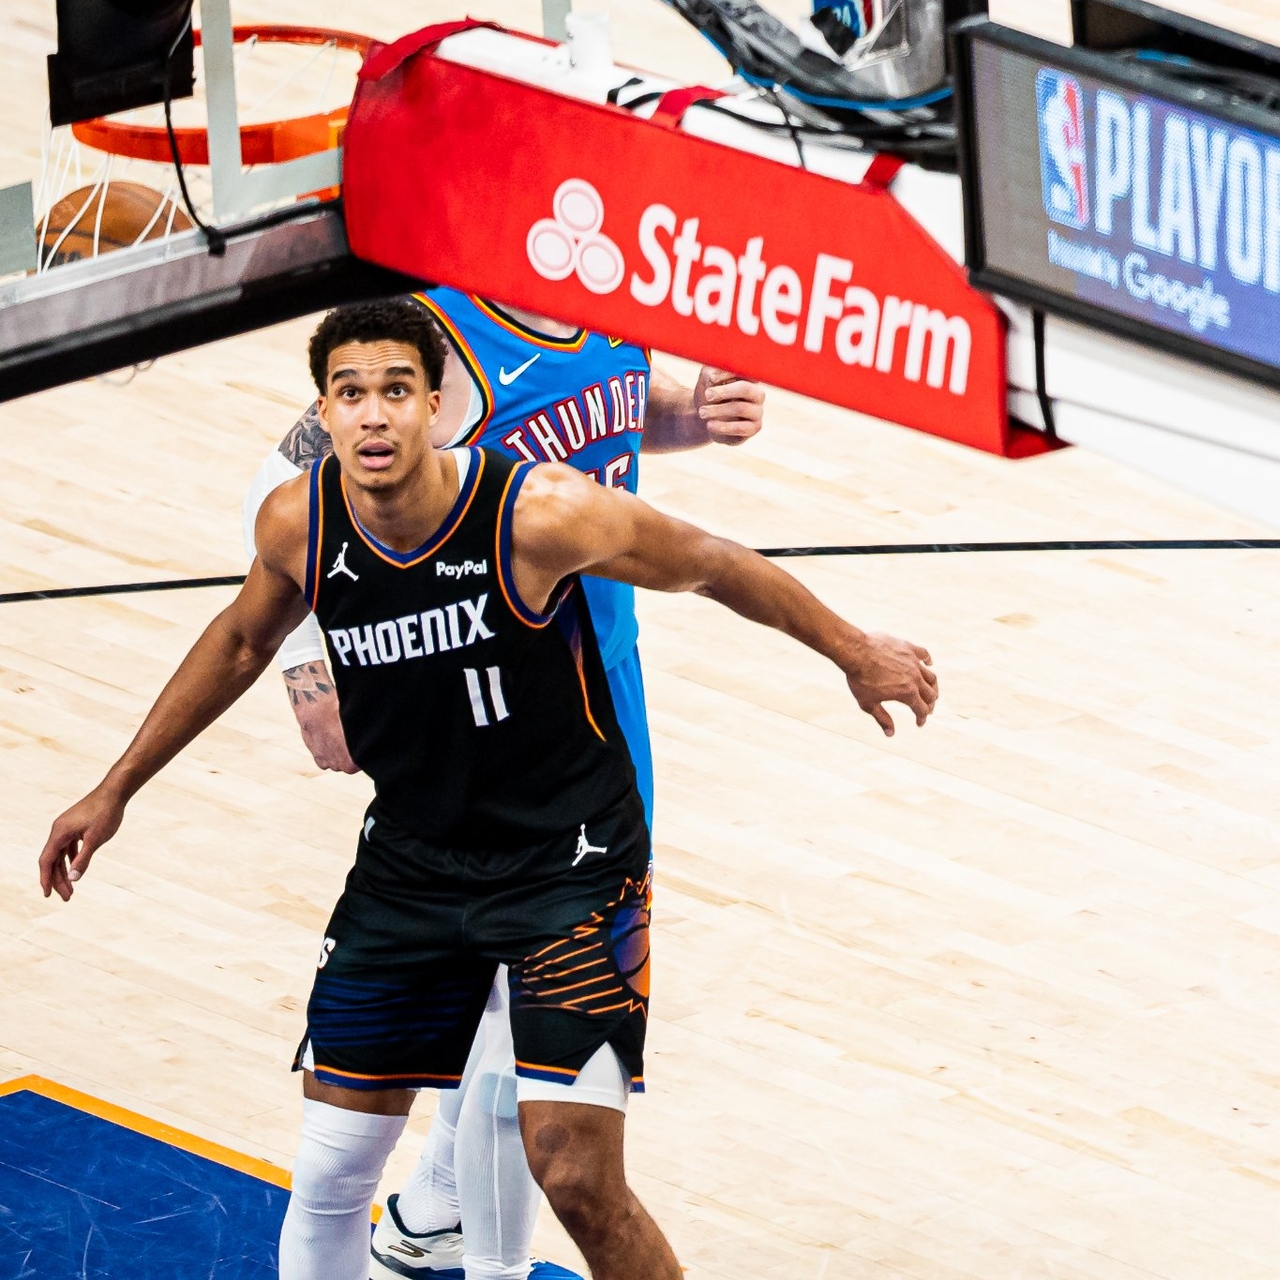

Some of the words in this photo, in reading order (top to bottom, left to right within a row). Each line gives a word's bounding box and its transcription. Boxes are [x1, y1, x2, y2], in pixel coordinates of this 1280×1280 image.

[501, 372, 645, 463] THUNDER
[436, 558, 488, 580] PayPal
[328, 592, 496, 666] PHOENIX
[463, 665, 510, 727] 11
